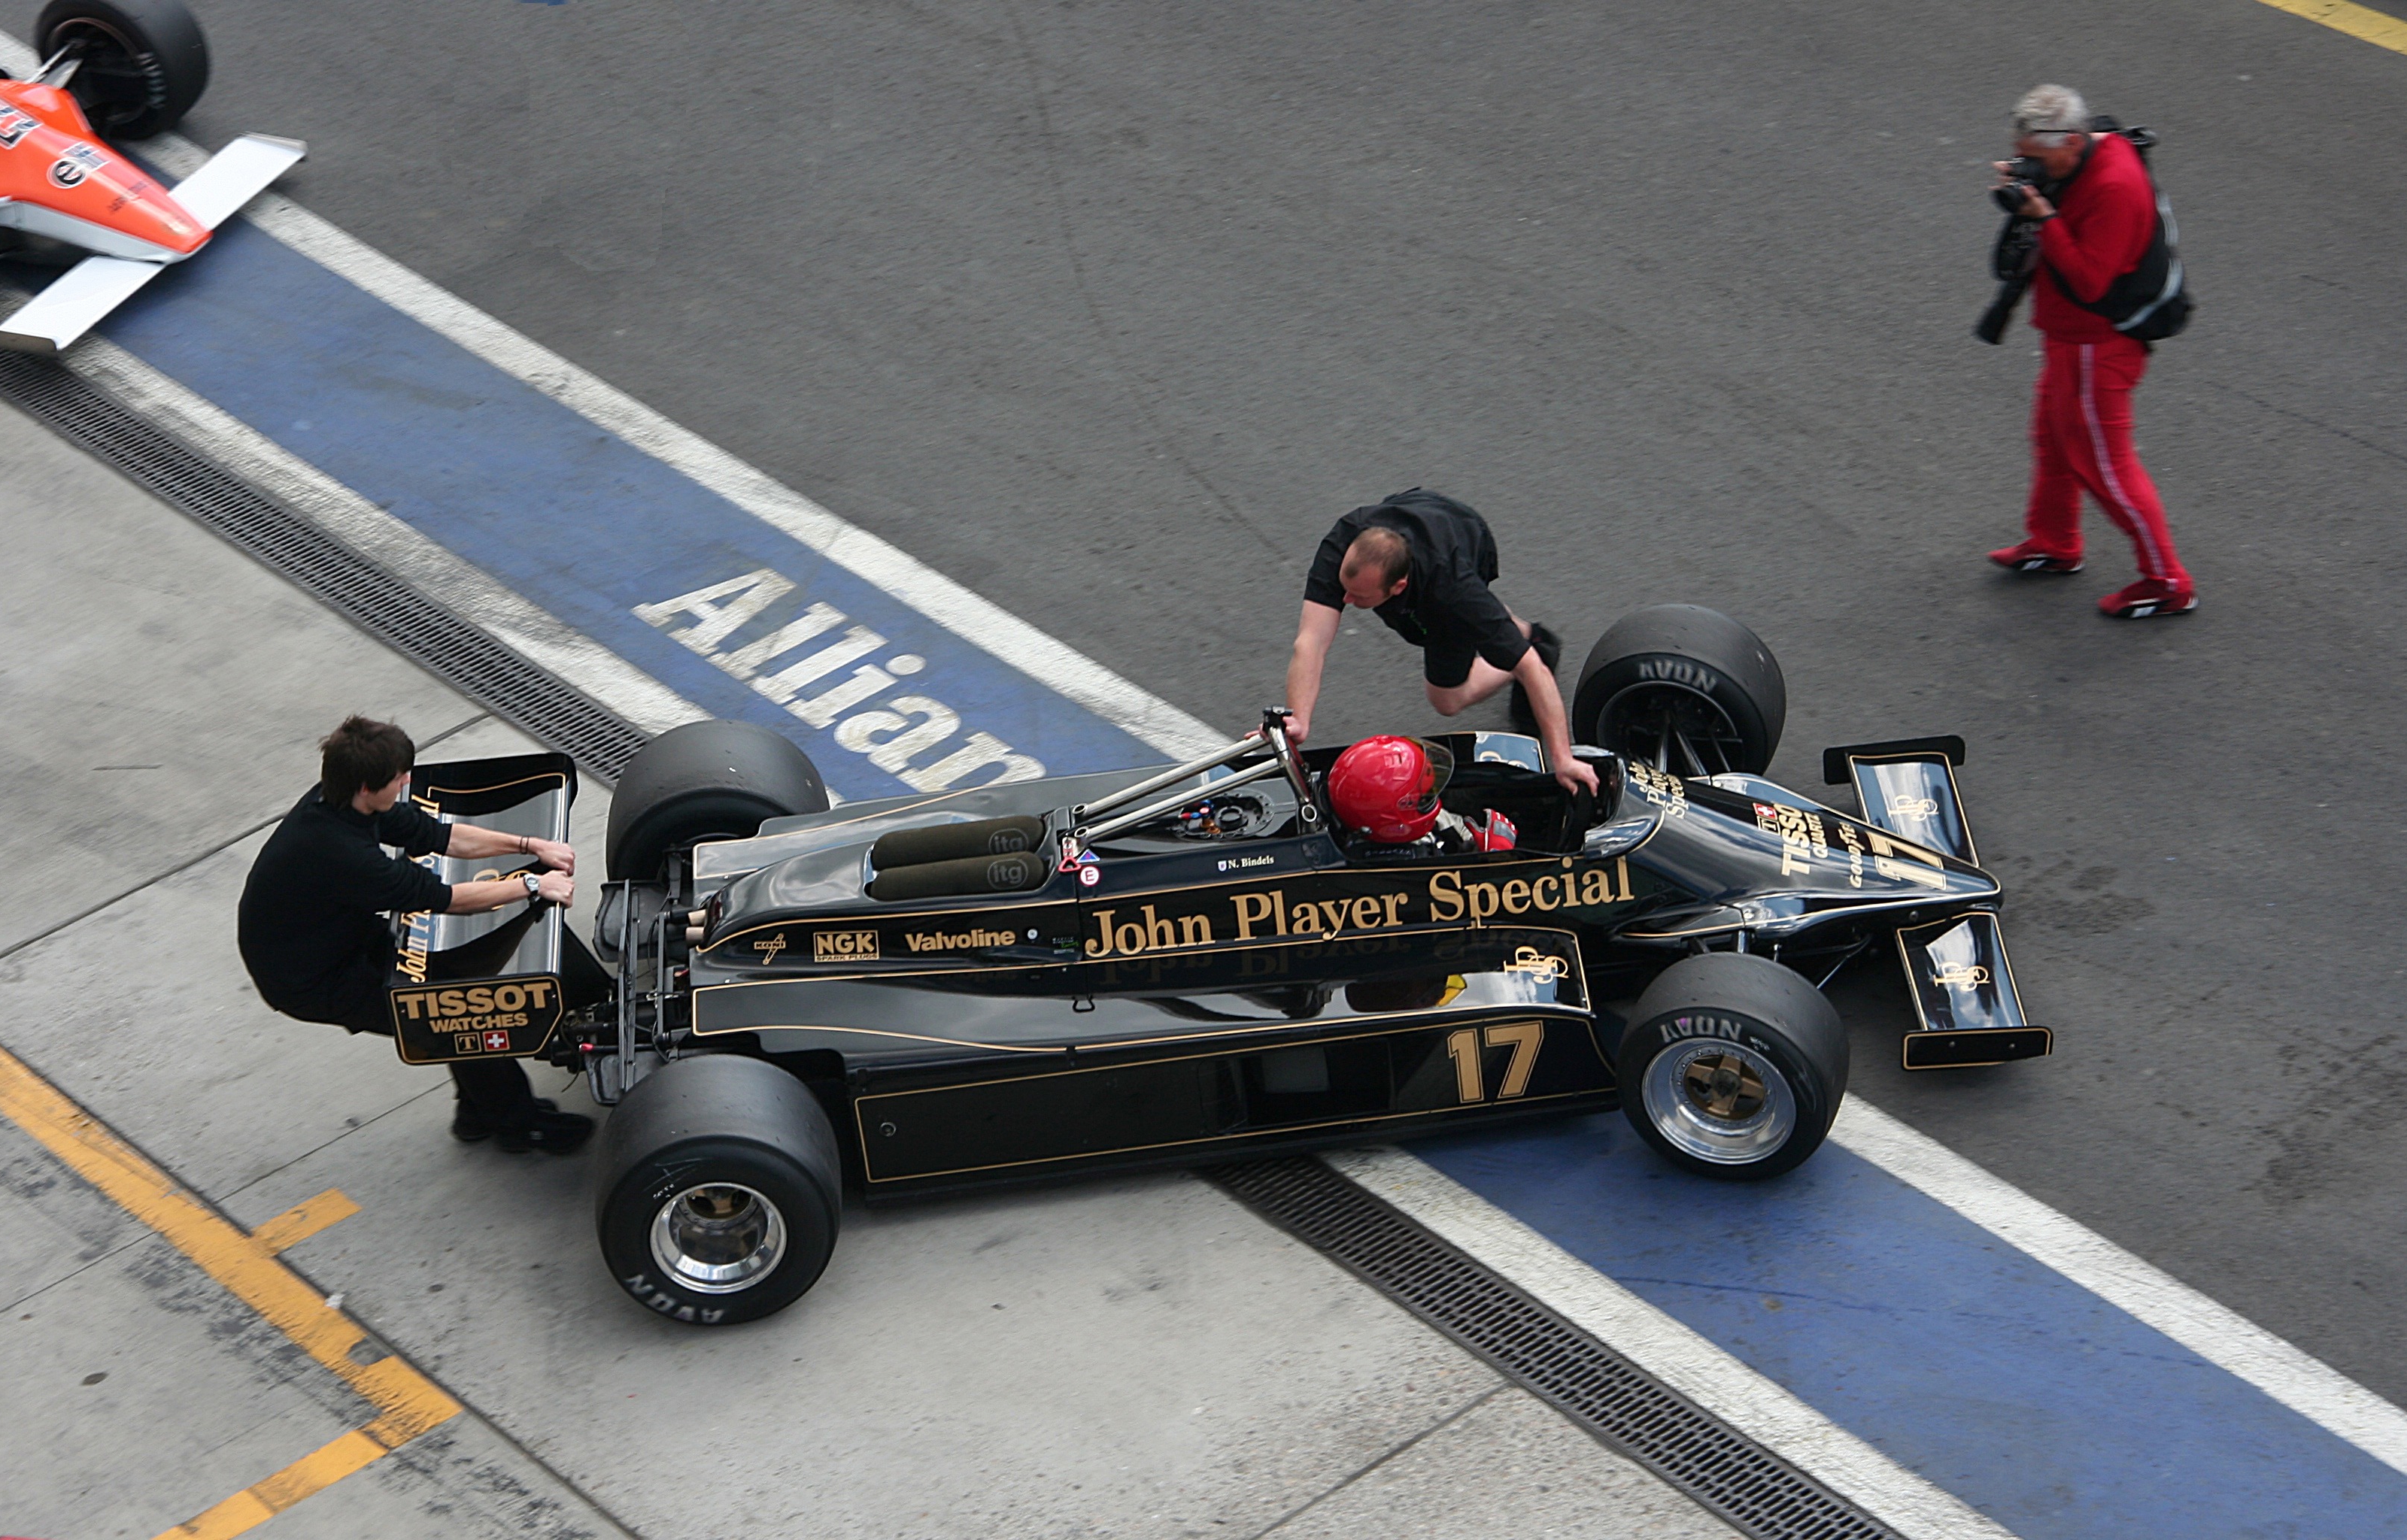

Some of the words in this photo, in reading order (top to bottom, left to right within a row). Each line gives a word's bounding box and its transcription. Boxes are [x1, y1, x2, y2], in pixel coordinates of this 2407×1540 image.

[1640, 659, 1717, 693] AVON
[1773, 802, 1811, 877] TISSO
[1804, 811, 1829, 859] QUARTZ
[993, 863, 1023, 884] itg
[1228, 859, 1240, 869] N.
[1241, 854, 1275, 868] Bindels
[1865, 830, 1947, 890] 17
[1085, 904, 1216, 959] John
[1230, 890, 1409, 941] Player
[1429, 856, 1635, 929] Special
[817, 933, 875, 955] NGK
[905, 928, 1016, 953] Valvoline
[396, 937, 428, 984] John
[397, 982, 551, 1020] TISSOT
[429, 1012, 529, 1034] WATCHES
[1659, 1015, 1742, 1043] AVON
[1448, 1020, 1544, 1104] 17
[625, 1274, 724, 1323] AVON
